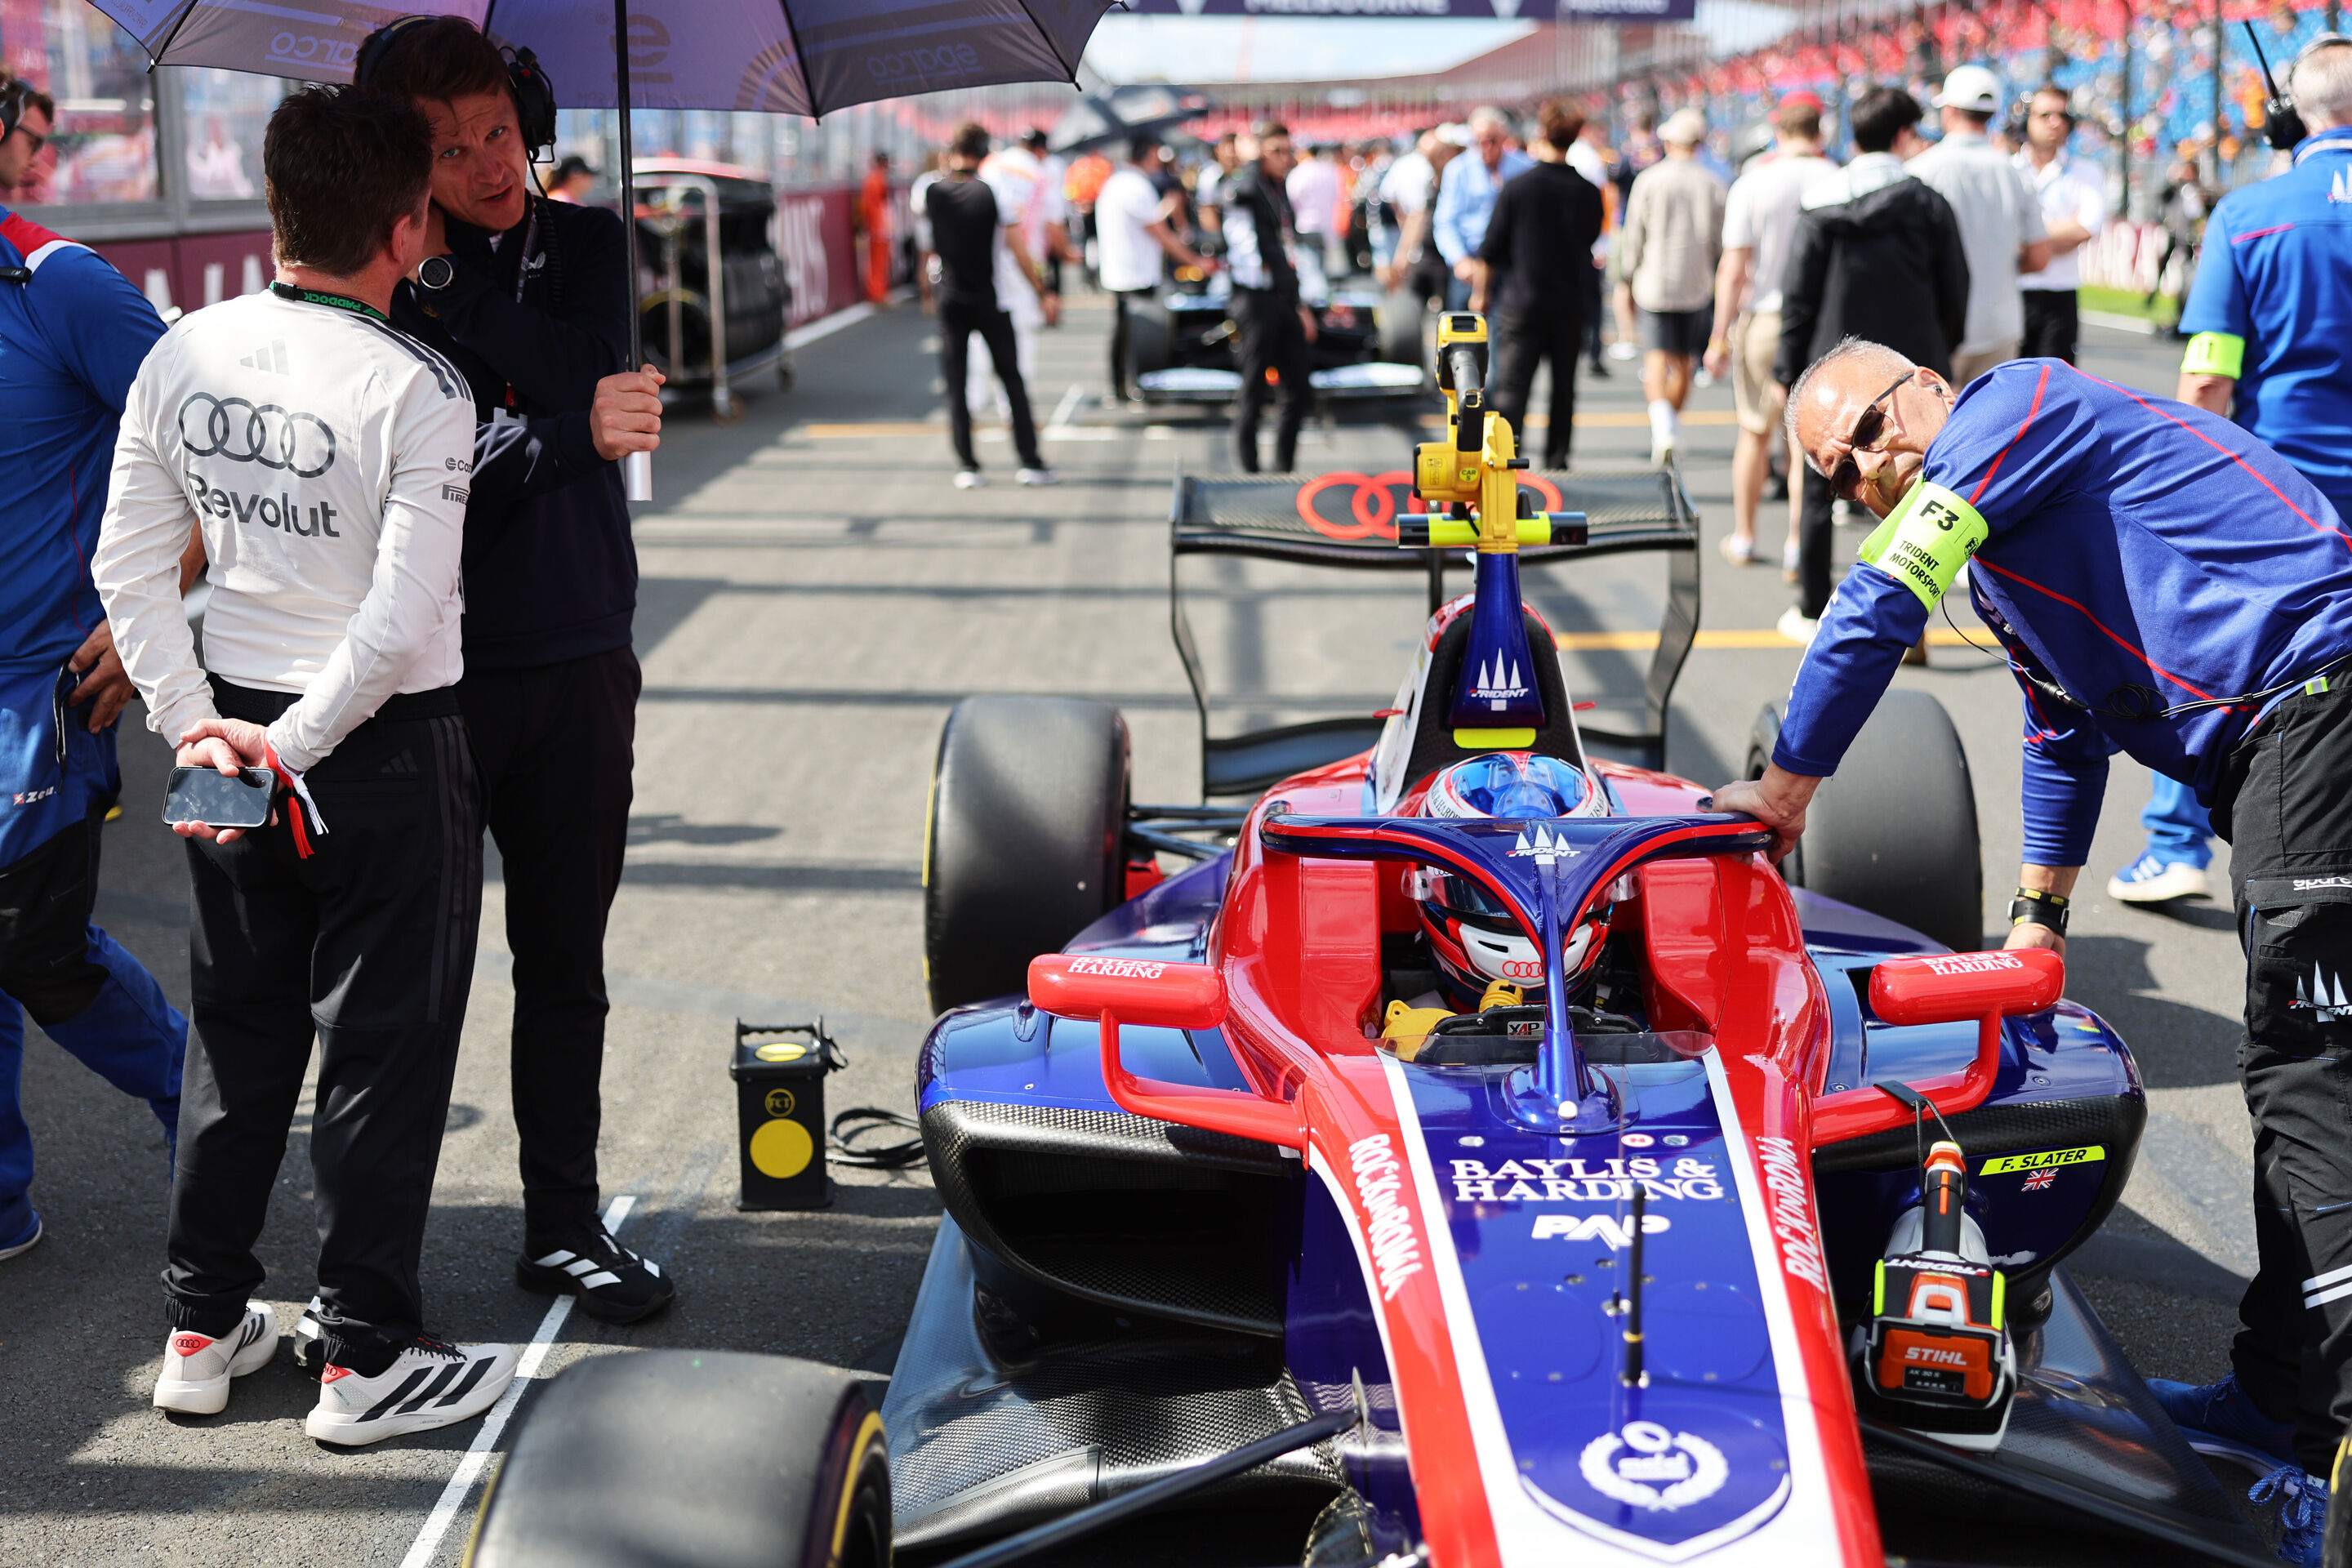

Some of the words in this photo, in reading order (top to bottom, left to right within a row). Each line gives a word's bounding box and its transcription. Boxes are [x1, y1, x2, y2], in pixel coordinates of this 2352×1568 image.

[304, 292, 361, 311] PADDOCK
[186, 470, 340, 537] Revolut
[1919, 499, 1960, 532] F3
[1899, 540, 1940, 571] TRIDENT
[1888, 553, 1941, 599] MOTORSPORT
[1468, 688, 1529, 699] TRIDENT
[1505, 847, 1581, 858] TRIDENT
[1067, 962, 1163, 979] HARDING
[1929, 957, 2024, 975] HARDING
[2000, 1158, 2015, 1171] F.
[2020, 1141, 2087, 1169] SLATER
[1450, 1159, 1661, 1180] BAYLIS
[1673, 1158, 1717, 1178] &
[1452, 1178, 1725, 1201] HARDING
[1884, 1258, 1990, 1276] TRIDENT
[1904, 1347, 1967, 1365] STIHL
